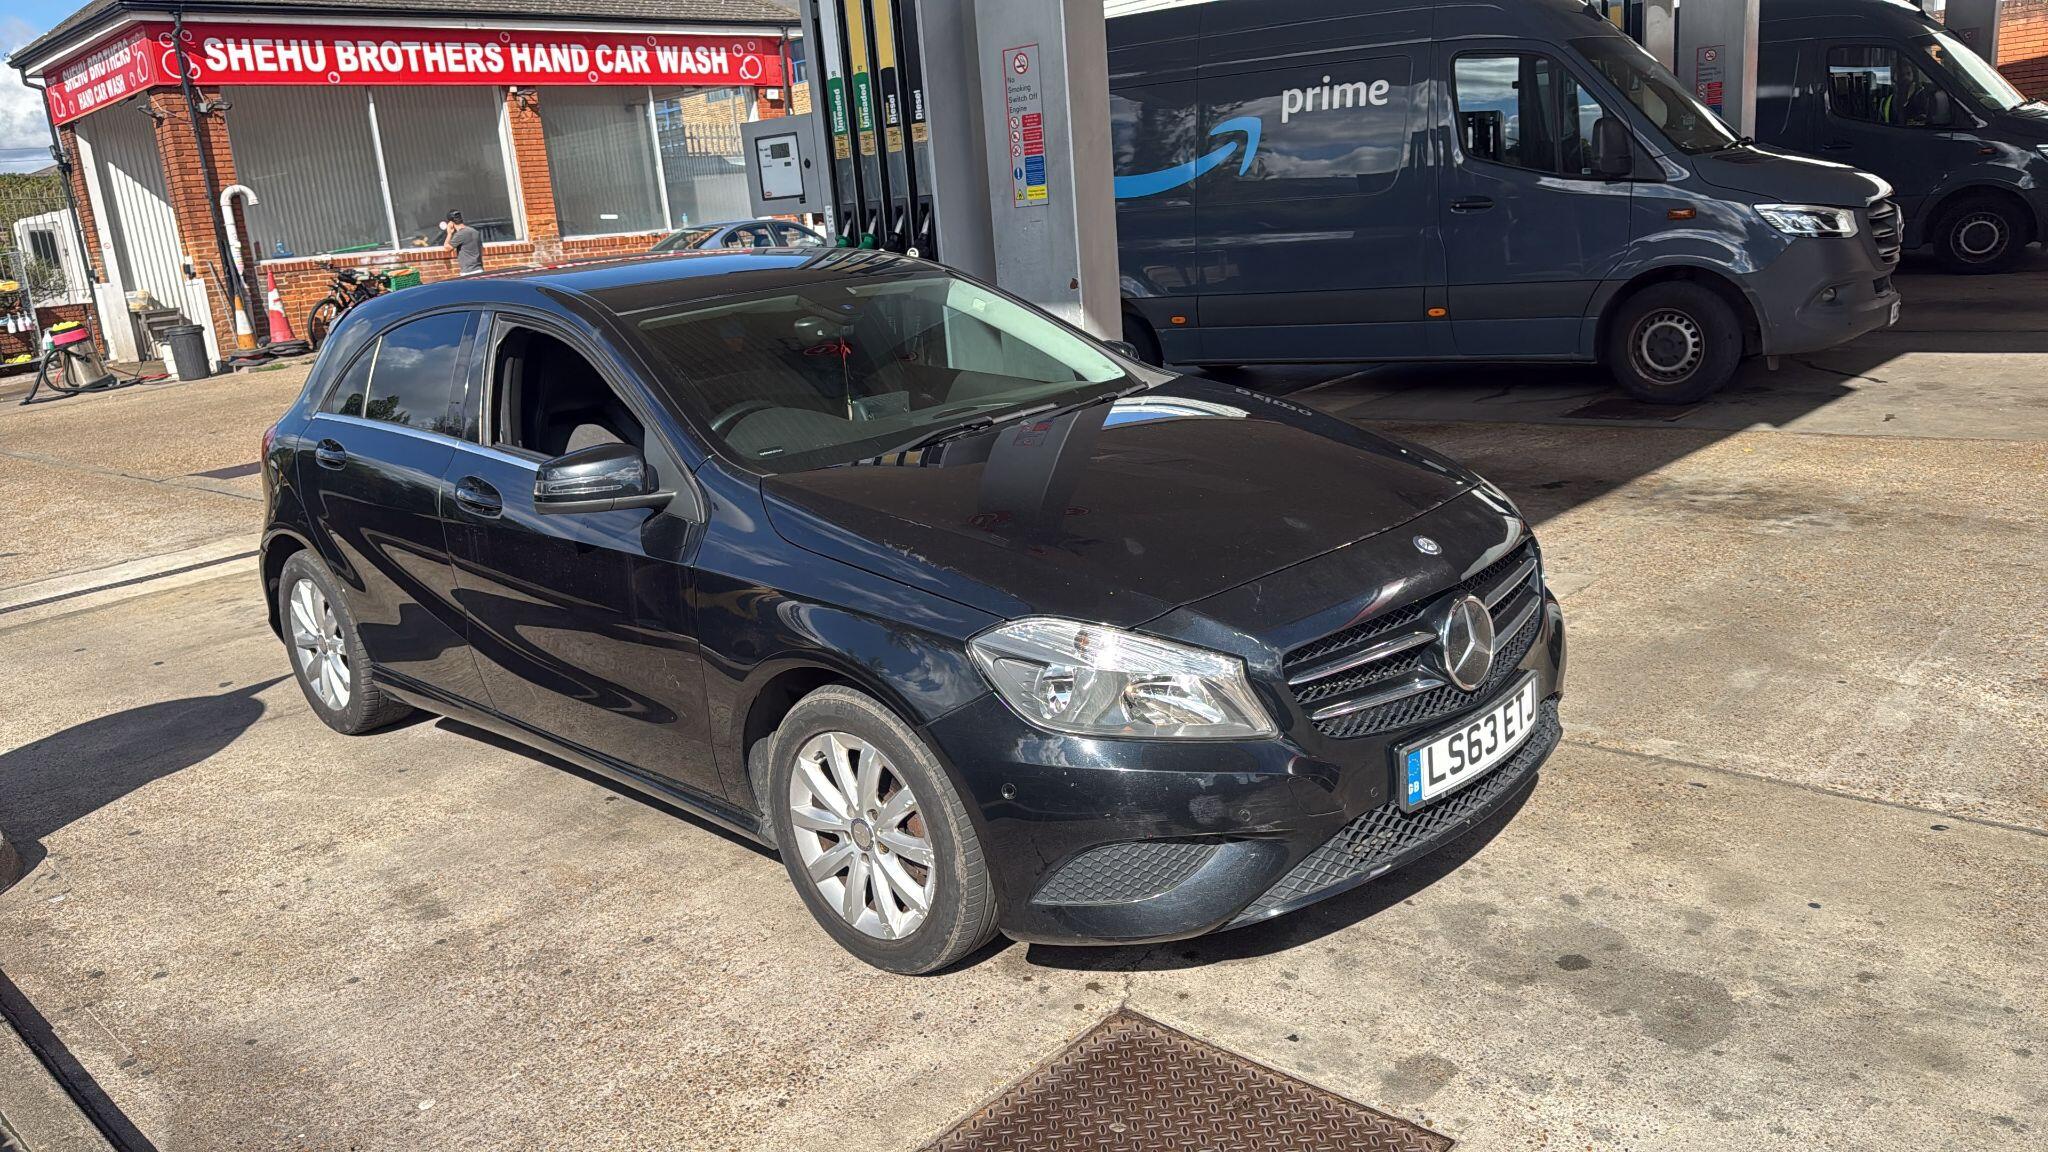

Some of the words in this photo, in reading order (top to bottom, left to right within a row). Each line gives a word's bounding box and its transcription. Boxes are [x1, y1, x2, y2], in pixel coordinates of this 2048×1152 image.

[204, 37, 327, 72] SHEHU
[334, 40, 504, 73] BROTHERS
[509, 42, 590, 73] HAND
[595, 44, 651, 74] CAR
[655, 46, 729, 74] WASH
[77, 90, 94, 110] HAND
[94, 84, 108, 103] CAR
[107, 75, 125, 98] WASH
[859, 83, 870, 128] Unleaded
[913, 89, 923, 120] Diesel
[1008, 84, 1031, 93] Smoking
[1008, 95, 1027, 103] Switch
[1282, 75, 1390, 124] prime
[833, 88, 844, 132] Unleaded
[887, 94, 898, 124] Diesel
[1010, 106, 1027, 114] Engine
[1427, 713, 1499, 787] LS63
[1503, 680, 1535, 744] ETJ
